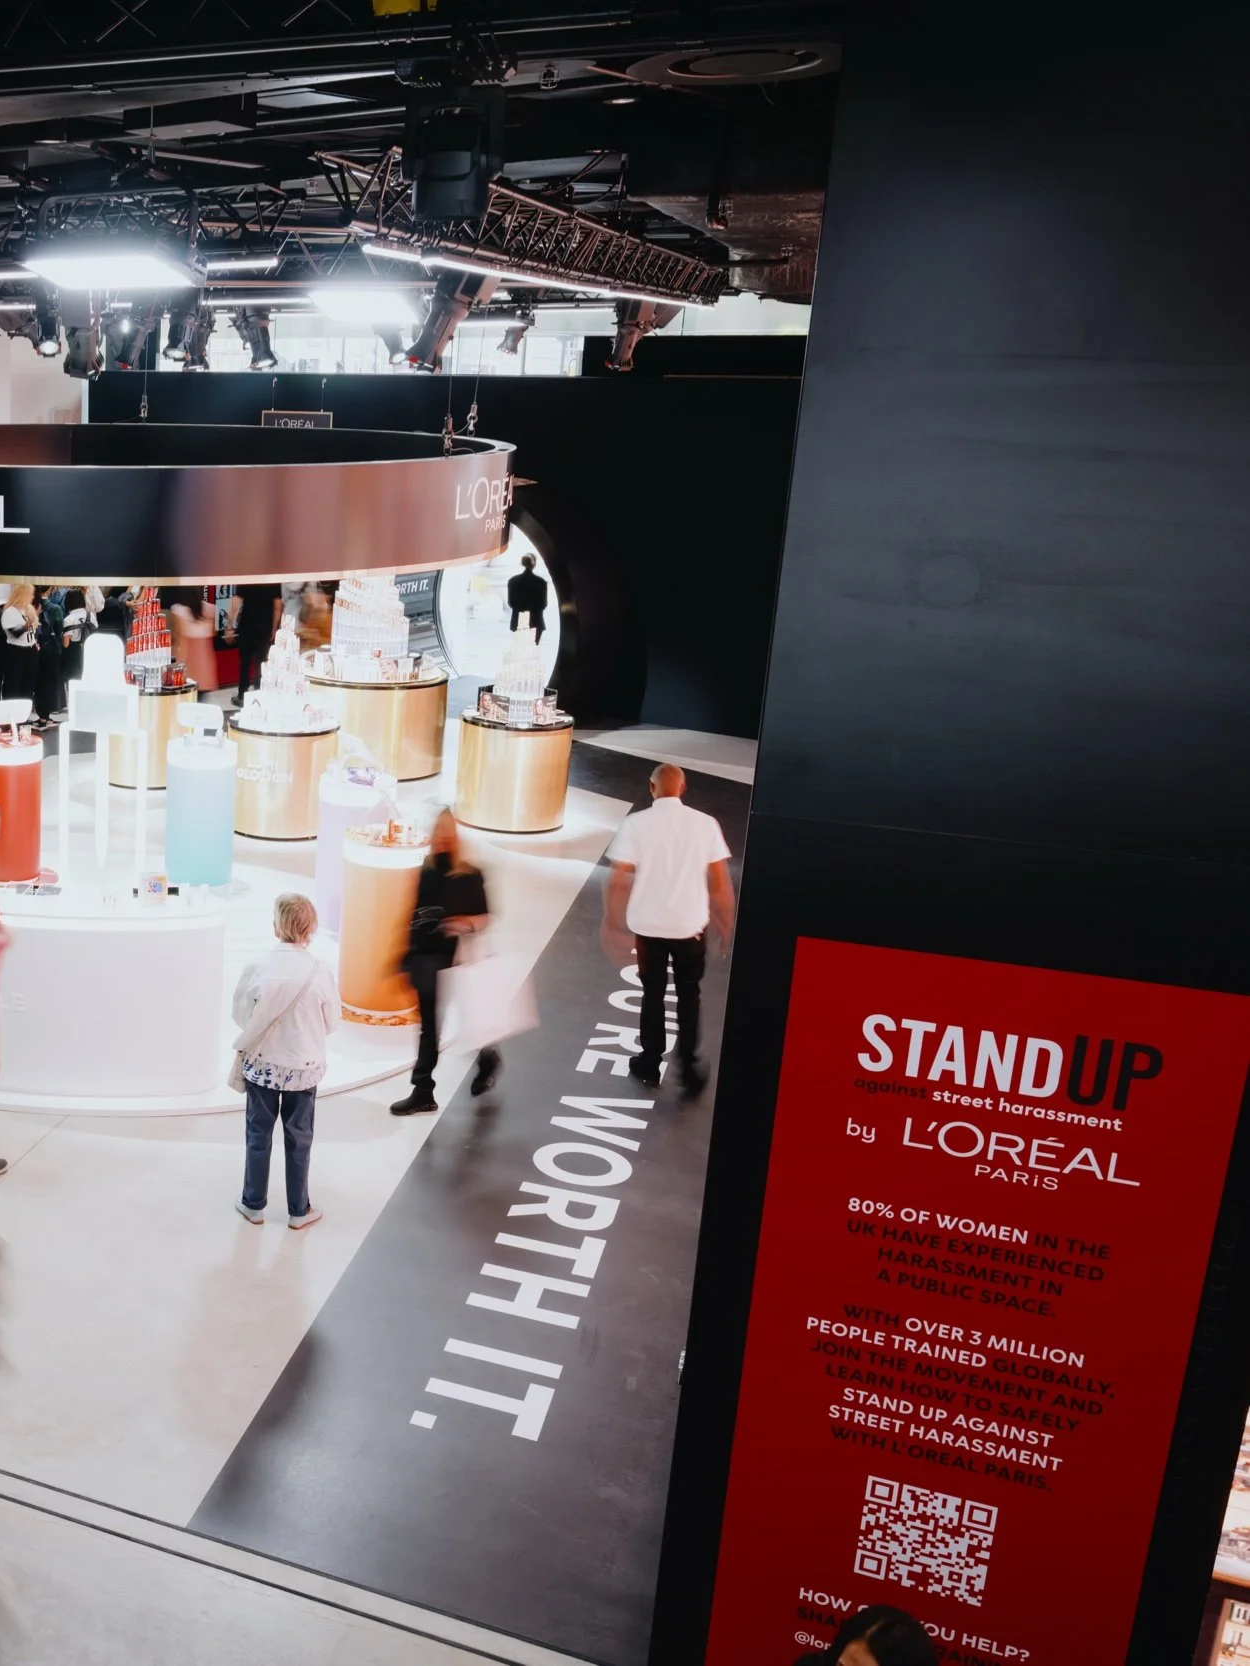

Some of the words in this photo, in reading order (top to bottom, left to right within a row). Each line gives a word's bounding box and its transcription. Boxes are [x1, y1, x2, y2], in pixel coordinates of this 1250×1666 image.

[854, 1077, 928, 1101] against
[932, 1089, 993, 1111] street
[999, 1098, 1123, 1132] harassment
[846, 1117, 876, 1143] by
[902, 1117, 1140, 1187] L'ORÉAL
[466, 1095, 656, 1330] WORTH
[848, 1197, 895, 1219] 80%
[900, 1208, 931, 1225] OF
[936, 1213, 1029, 1244] WOMEN
[1034, 1232, 1059, 1250] IN
[1066, 1239, 1111, 1260] THE
[846, 1220, 876, 1238] UK
[882, 1226, 942, 1250] HAVE
[947, 1239, 1104, 1281] EXPERIENCED
[877, 1247, 1034, 1289] HARASSMENT
[1039, 1279, 1063, 1297] IN
[876, 1269, 890, 1284] A
[897, 1272, 975, 1300] PUBLIC
[980, 1289, 1056, 1317] SPACE.
[806, 1316, 886, 1347] PEOPLE
[891, 1334, 987, 1368] TRAINED
[992, 1358, 1115, 1399] GLOBALLY,
[843, 1303, 900, 1328] WITH
[905, 1317, 964, 1342] OVER
[969, 1330, 983, 1346] 3
[987, 1334, 1085, 1368] MILLION
[409, 1338, 563, 1441] IT.
[811, 1339, 861, 1361] JOIN
[869, 1351, 908, 1372] THE
[913, 1361, 1046, 1401] MOVEMENT
[1053, 1393, 1104, 1416] AND
[826, 1362, 895, 1391] LEARN
[900, 1381, 954, 1403] HOW
[962, 1393, 992, 1412] TO
[997, 1400, 1080, 1432] SAFELY
[828, 1404, 904, 1434] STREET
[909, 1423, 1064, 1472] HARASSMENT
[831, 1424, 886, 1450] WITH
[843, 1387, 914, 1415] STAND
[919, 1404, 948, 1422] UP
[952, 1413, 1054, 1448] AGAINST
[798, 1587, 852, 1612] HOW
[920, 1620, 956, 1641] OU
[962, 1632, 1030, 1662] HELP?
